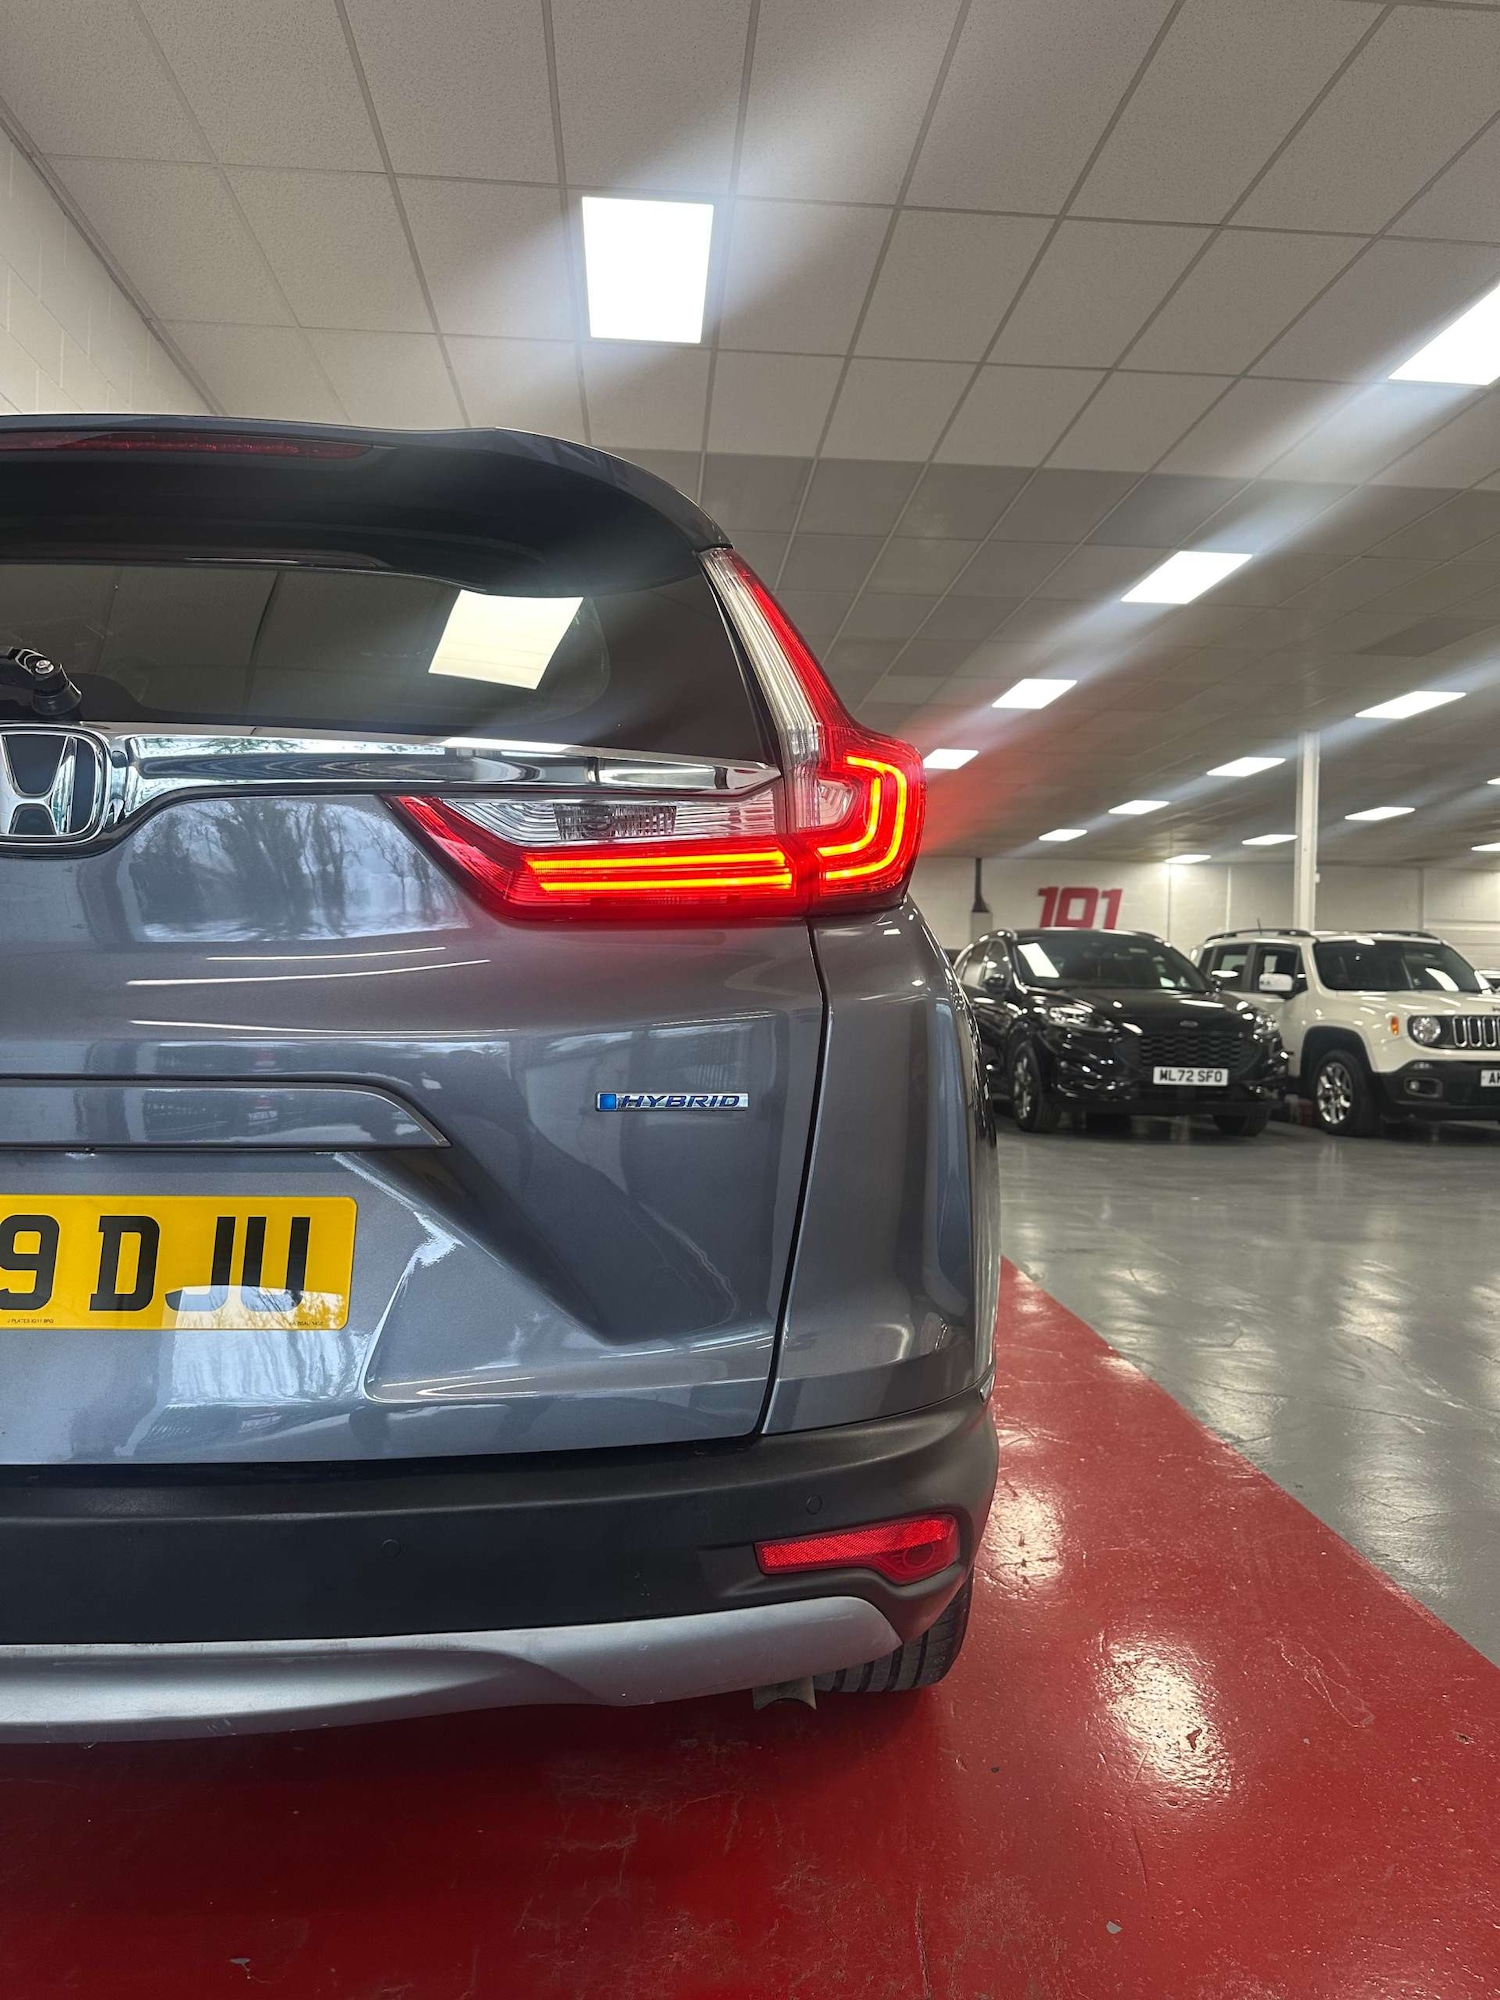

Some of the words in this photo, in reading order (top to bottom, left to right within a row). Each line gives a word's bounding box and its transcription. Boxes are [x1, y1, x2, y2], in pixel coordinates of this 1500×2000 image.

[1038, 886, 1122, 929] 101
[1159, 1069, 1194, 1082] ML72
[621, 1095, 740, 1107] HYBRID
[0, 1214, 60, 1311] 9
[89, 1215, 311, 1312] DJU
